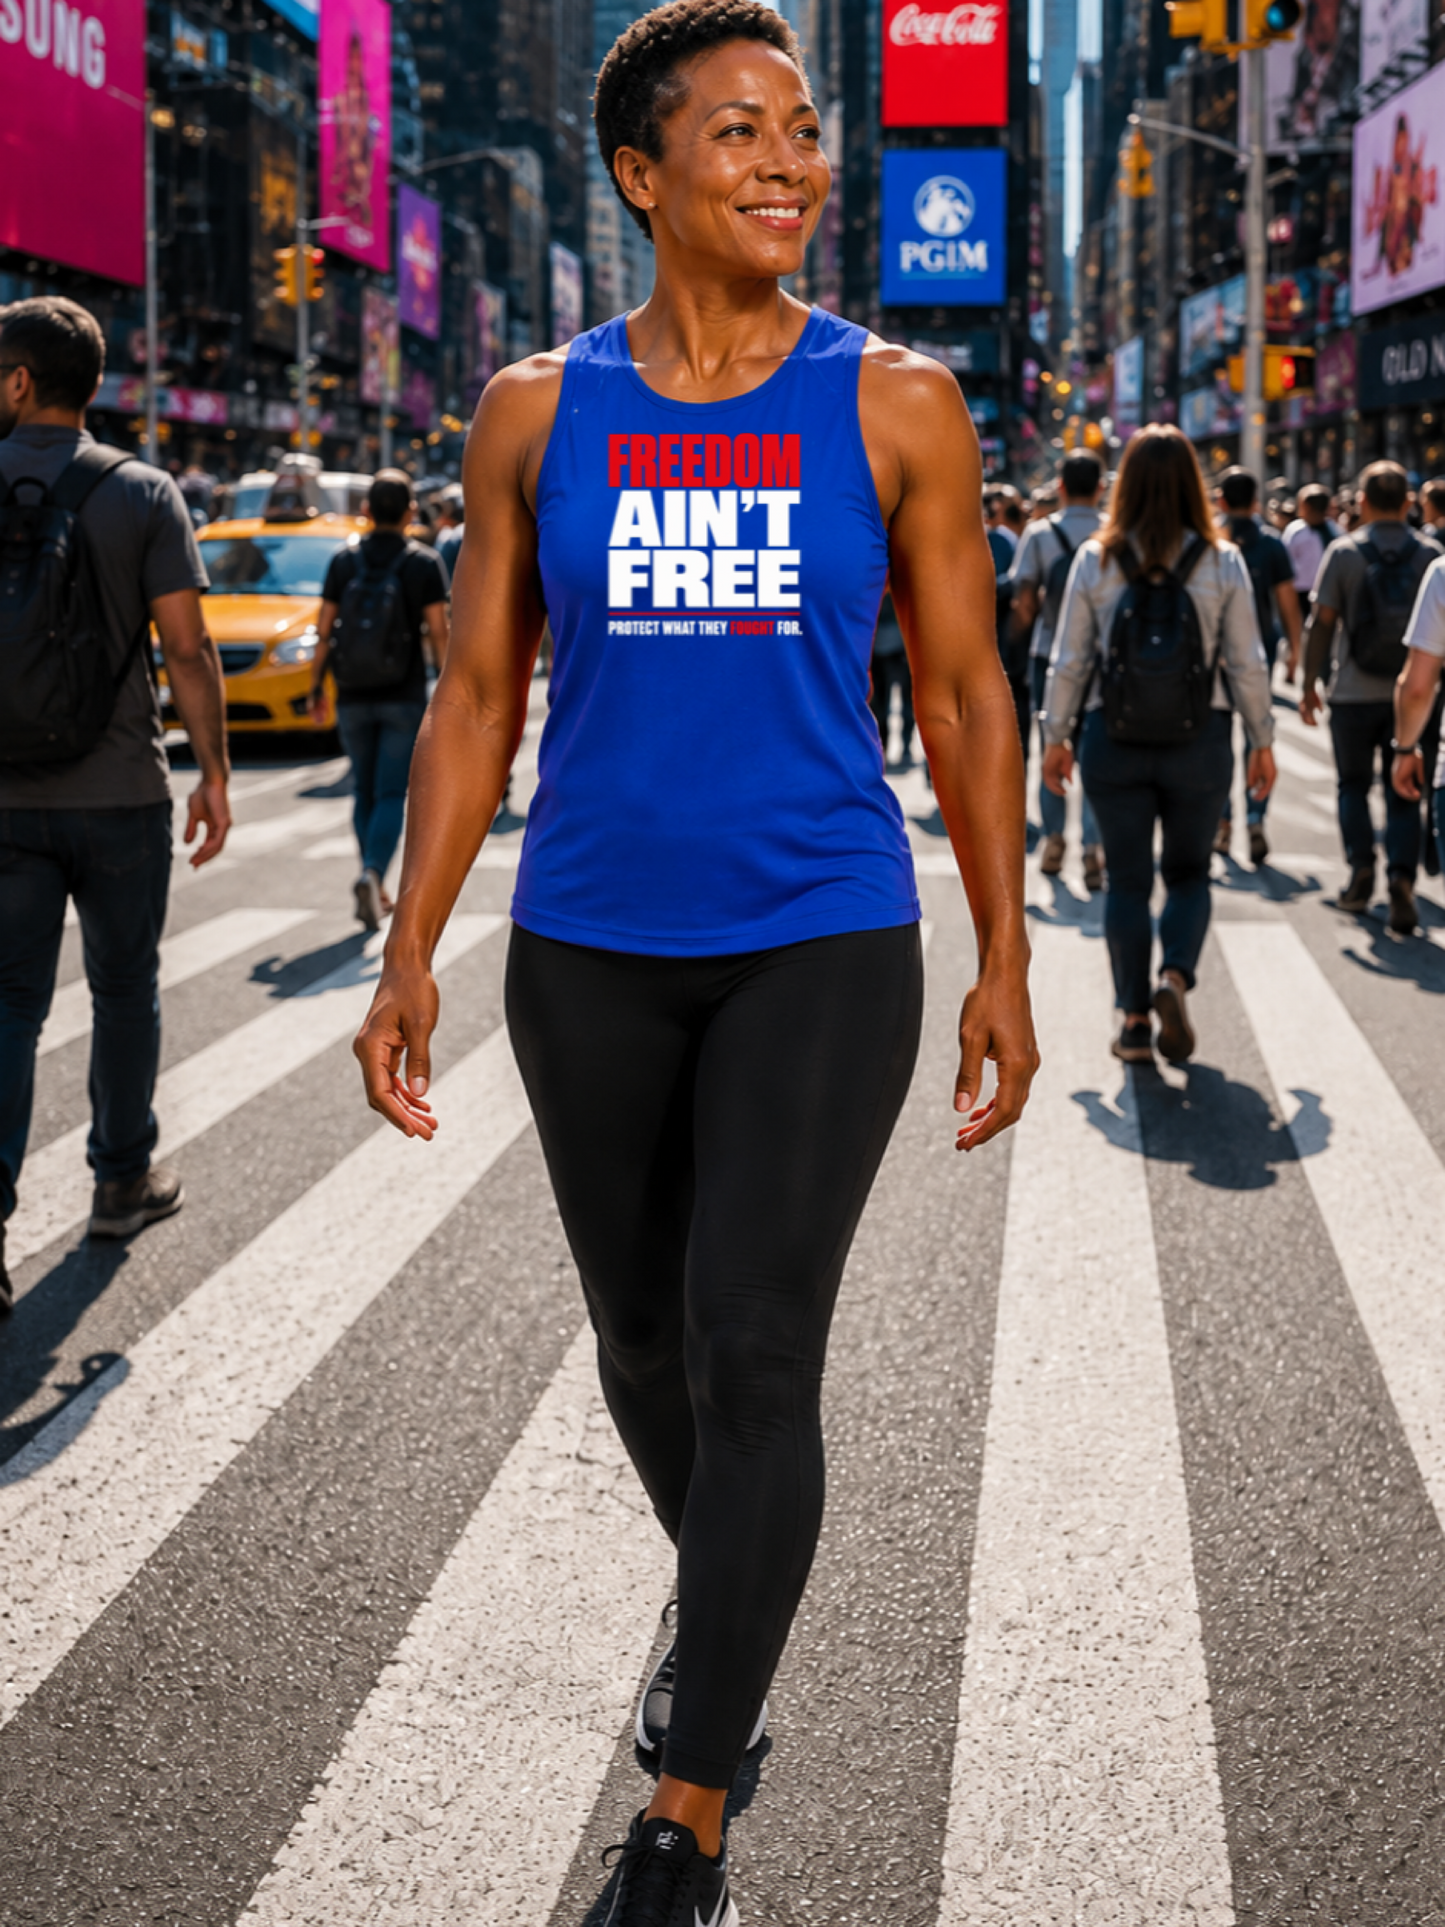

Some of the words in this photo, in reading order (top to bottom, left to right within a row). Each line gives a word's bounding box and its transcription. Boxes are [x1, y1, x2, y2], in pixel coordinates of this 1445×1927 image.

[900, 240, 988, 272] PGIM
[608, 433, 800, 487] FREEDOM
[608, 490, 800, 547] AIN'T
[608, 550, 800, 608] FREE
[608, 620, 660, 635] PROTECT
[662, 620, 695, 635] WHAT
[698, 620, 727, 635] THEY
[730, 620, 774, 635] FOUGHT
[777, 620, 803, 635] FOR.
